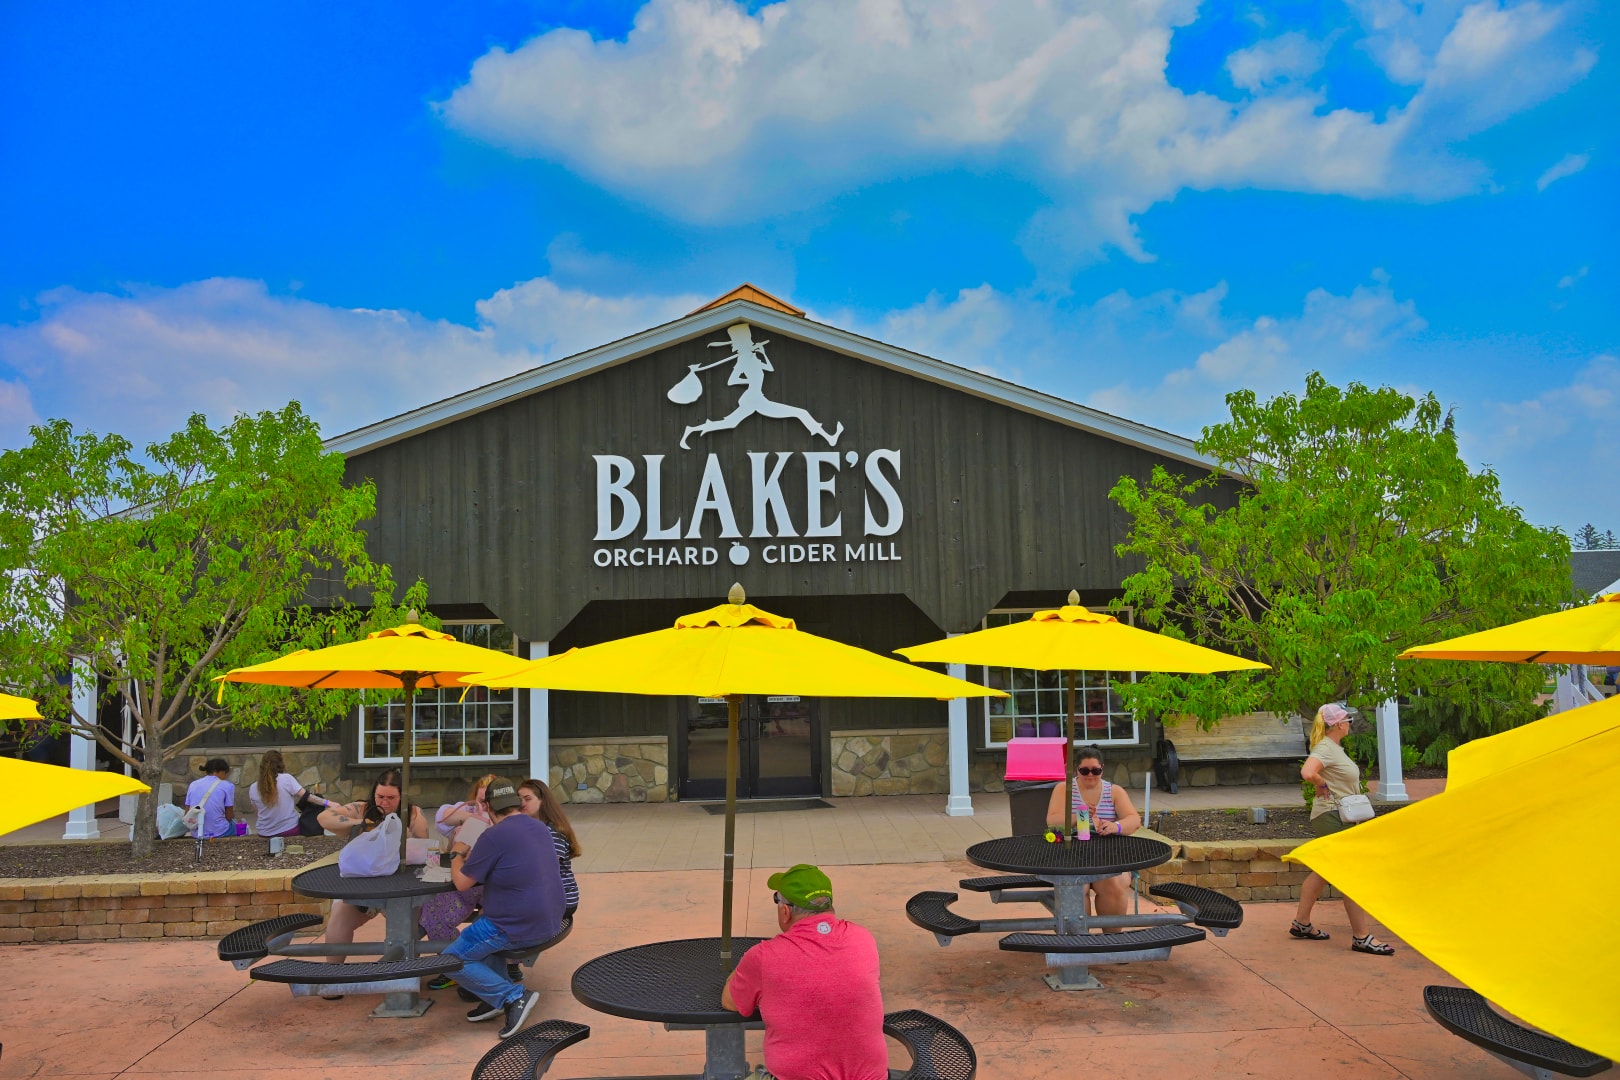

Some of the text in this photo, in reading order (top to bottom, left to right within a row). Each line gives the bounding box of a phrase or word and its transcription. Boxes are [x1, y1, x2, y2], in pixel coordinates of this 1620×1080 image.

[591, 448, 904, 541] BLAKE'S
[593, 542, 902, 567] ORCHARD CIDER MILL
